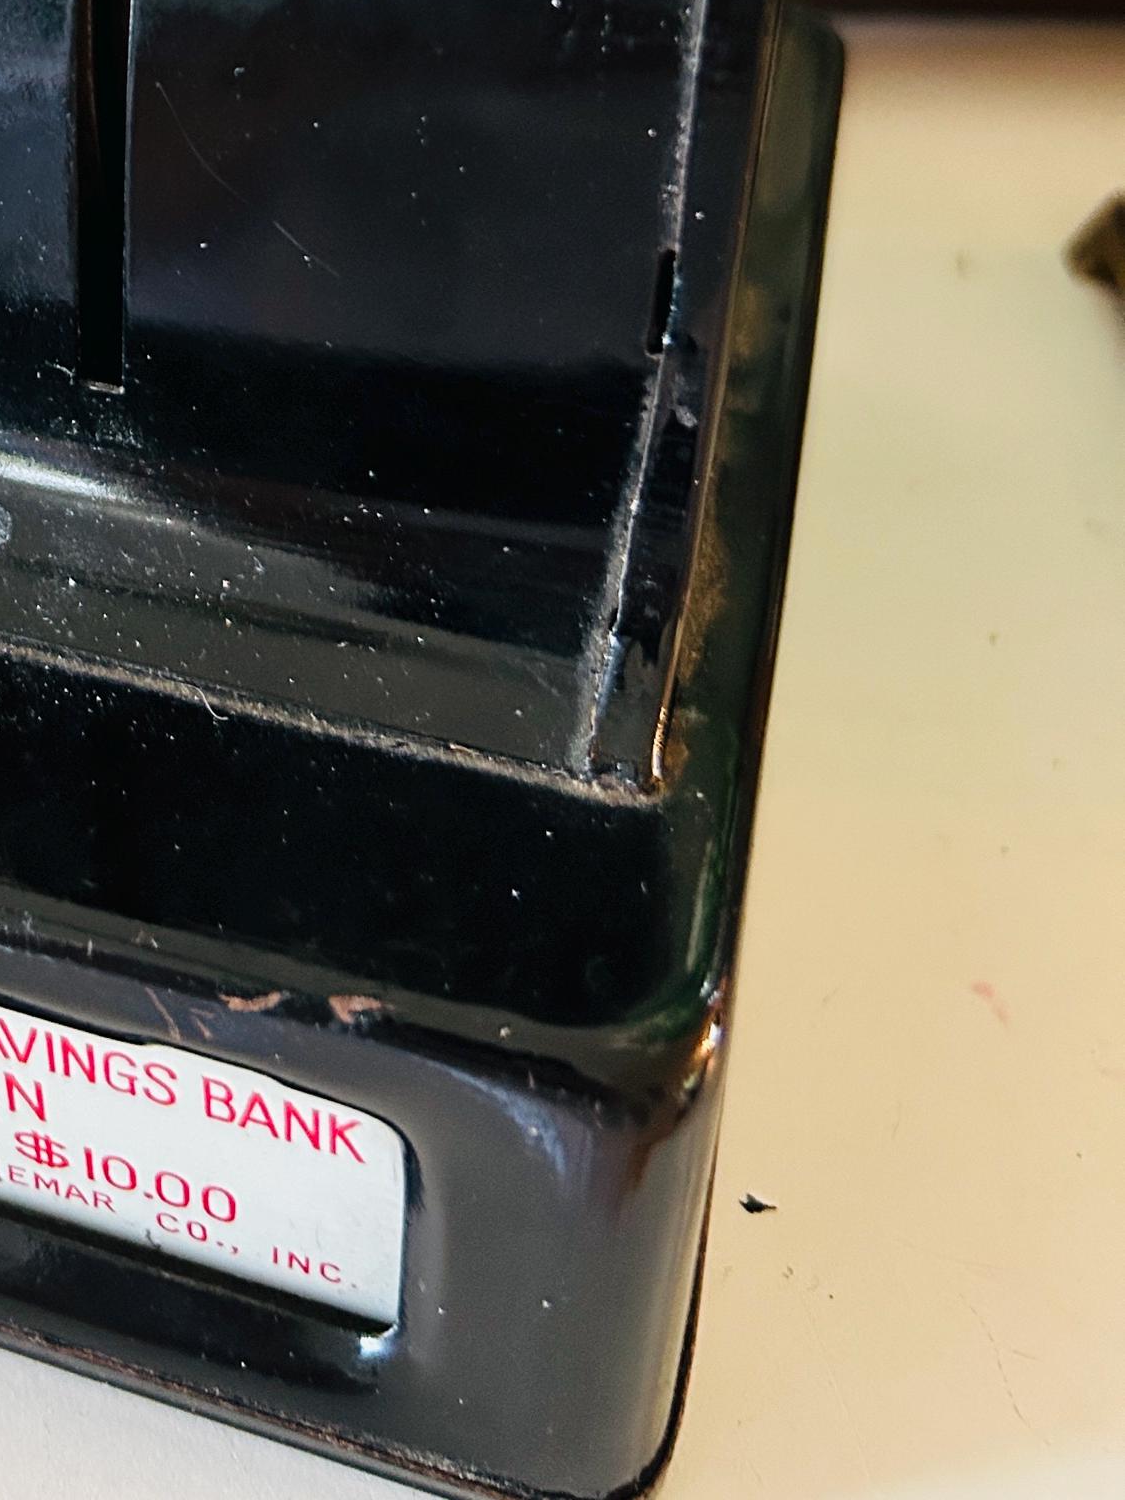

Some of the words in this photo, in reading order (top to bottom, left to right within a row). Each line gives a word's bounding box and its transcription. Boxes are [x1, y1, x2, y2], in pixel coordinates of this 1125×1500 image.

[201, 1074, 366, 1165] BANK
[13, 1130, 238, 1225] $10.00
[271, 1246, 359, 1289] INC.
